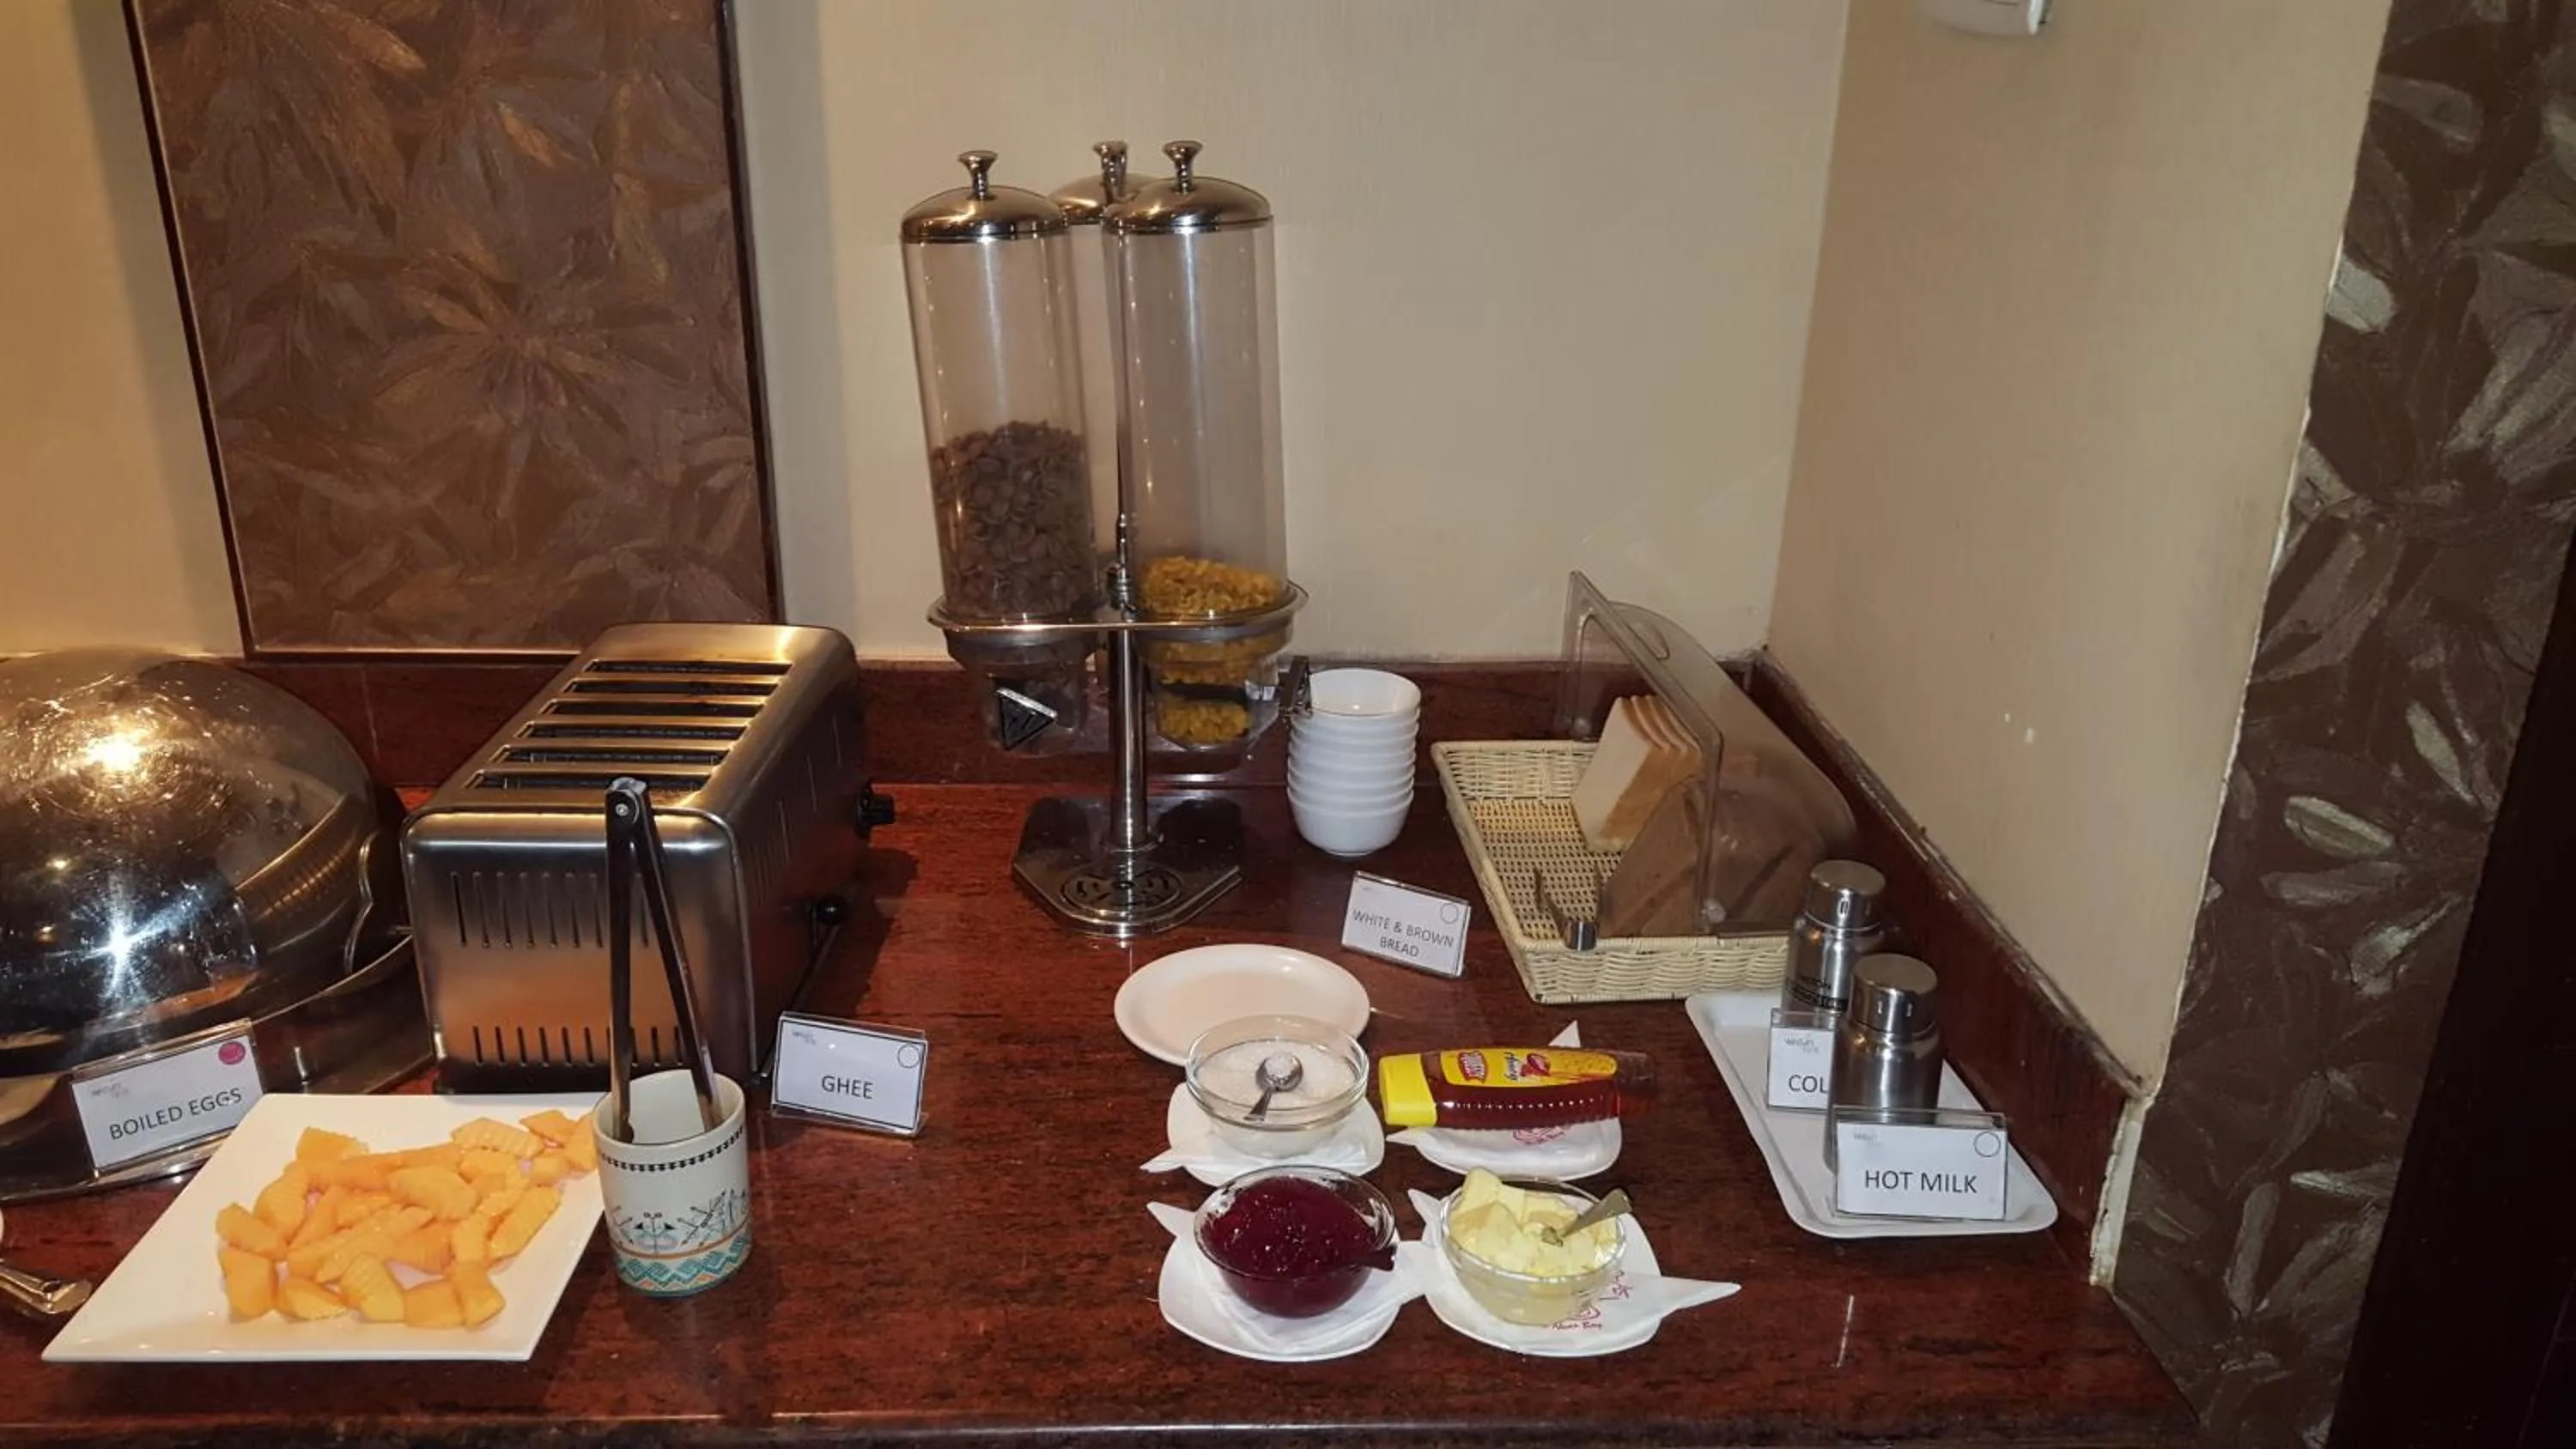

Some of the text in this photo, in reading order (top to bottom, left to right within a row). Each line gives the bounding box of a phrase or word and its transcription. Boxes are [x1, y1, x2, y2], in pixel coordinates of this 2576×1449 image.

[1352, 909, 1455, 948] WHITE & BROWN
[1380, 937, 1419, 957] BREAD
[822, 1075, 873, 1100] GHEE
[1789, 1075, 1829, 1094] COL
[109, 1088, 242, 1140] BOILED EGGS
[1865, 1170, 1978, 1194] HOT MILK
